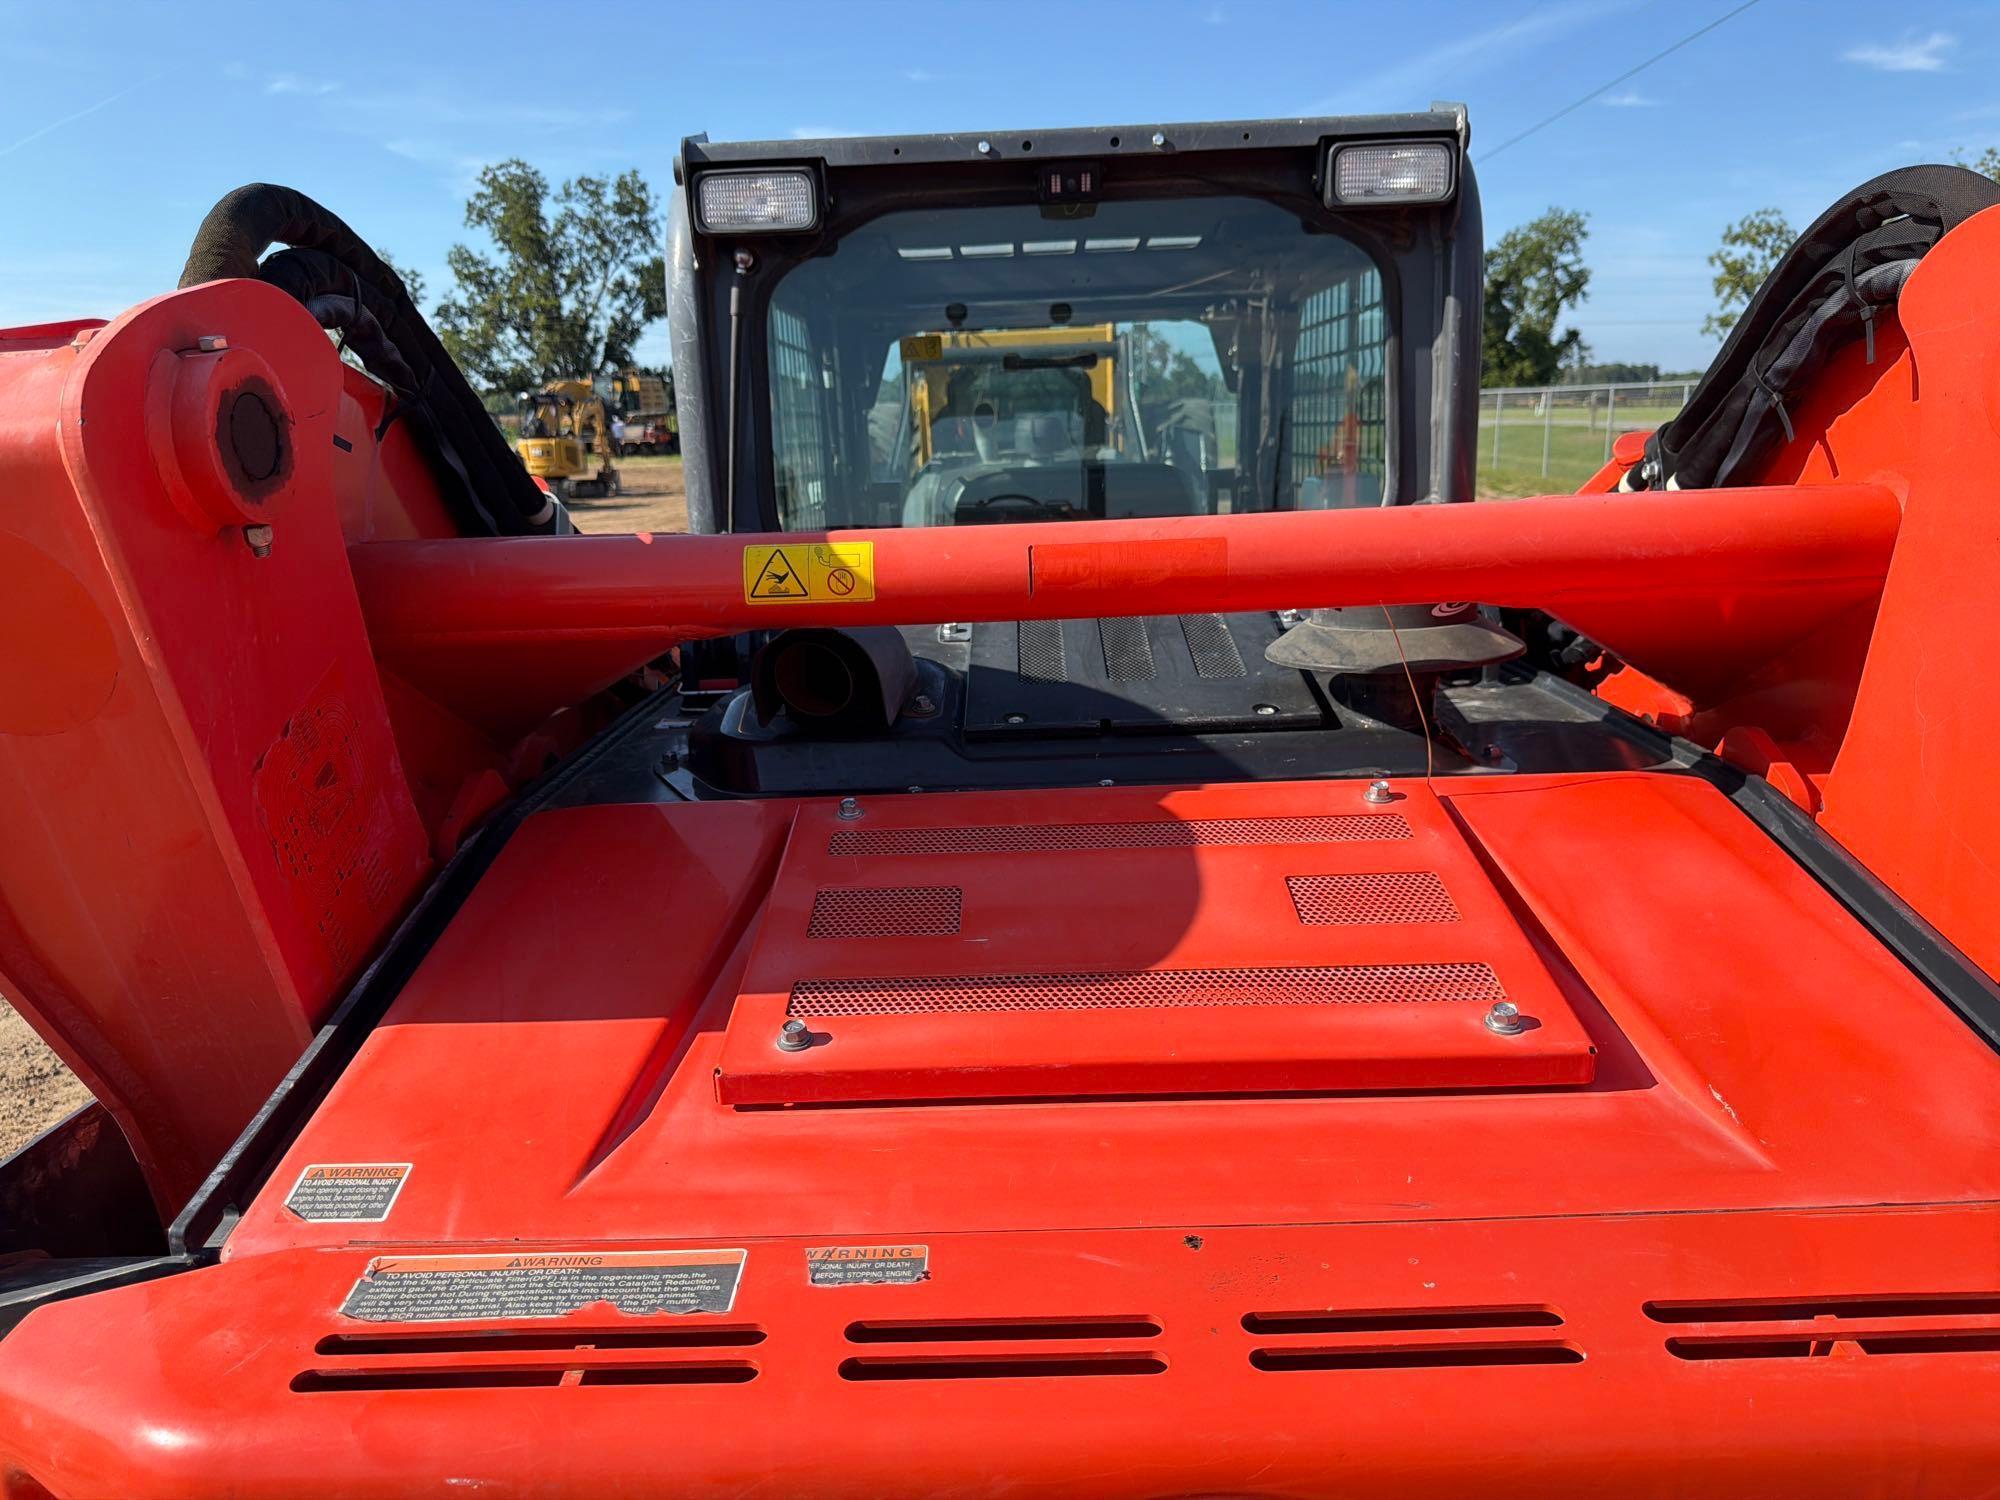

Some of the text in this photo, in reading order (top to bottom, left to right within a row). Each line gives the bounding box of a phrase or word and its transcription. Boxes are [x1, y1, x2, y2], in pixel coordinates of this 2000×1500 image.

[329, 1168, 400, 1177] WARNING
[372, 1178, 398, 1186] INJURY:
[317, 1187, 341, 1196] opening
[356, 1186, 378, 1195] closing
[292, 1195, 314, 1203] engine
[299, 1203, 314, 1211] your
[334, 1202, 361, 1210] pinched
[323, 1211, 339, 1219] body
[807, 1248, 912, 1259] WARNING
[523, 1257, 603, 1267] WARNING
[401, 1272, 434, 1280] AVOID
[434, 1271, 488, 1279] PERSONAL
[847, 1271, 883, 1279] STOPPING
[885, 1270, 912, 1278] ENGINE
[420, 1278, 450, 1286] Diesel
[453, 1277, 503, 1285] Particulate
[600, 1273, 660, 1282] regenerating
[408, 1286, 426, 1294] gas
[665, 1278, 717, 1286] Reduction)
[408, 1305, 458, 1313] flammable
[461, 1303, 502, 1311] material.
[529, 1301, 553, 1309] keep
[391, 1312, 414, 1320] SCR
